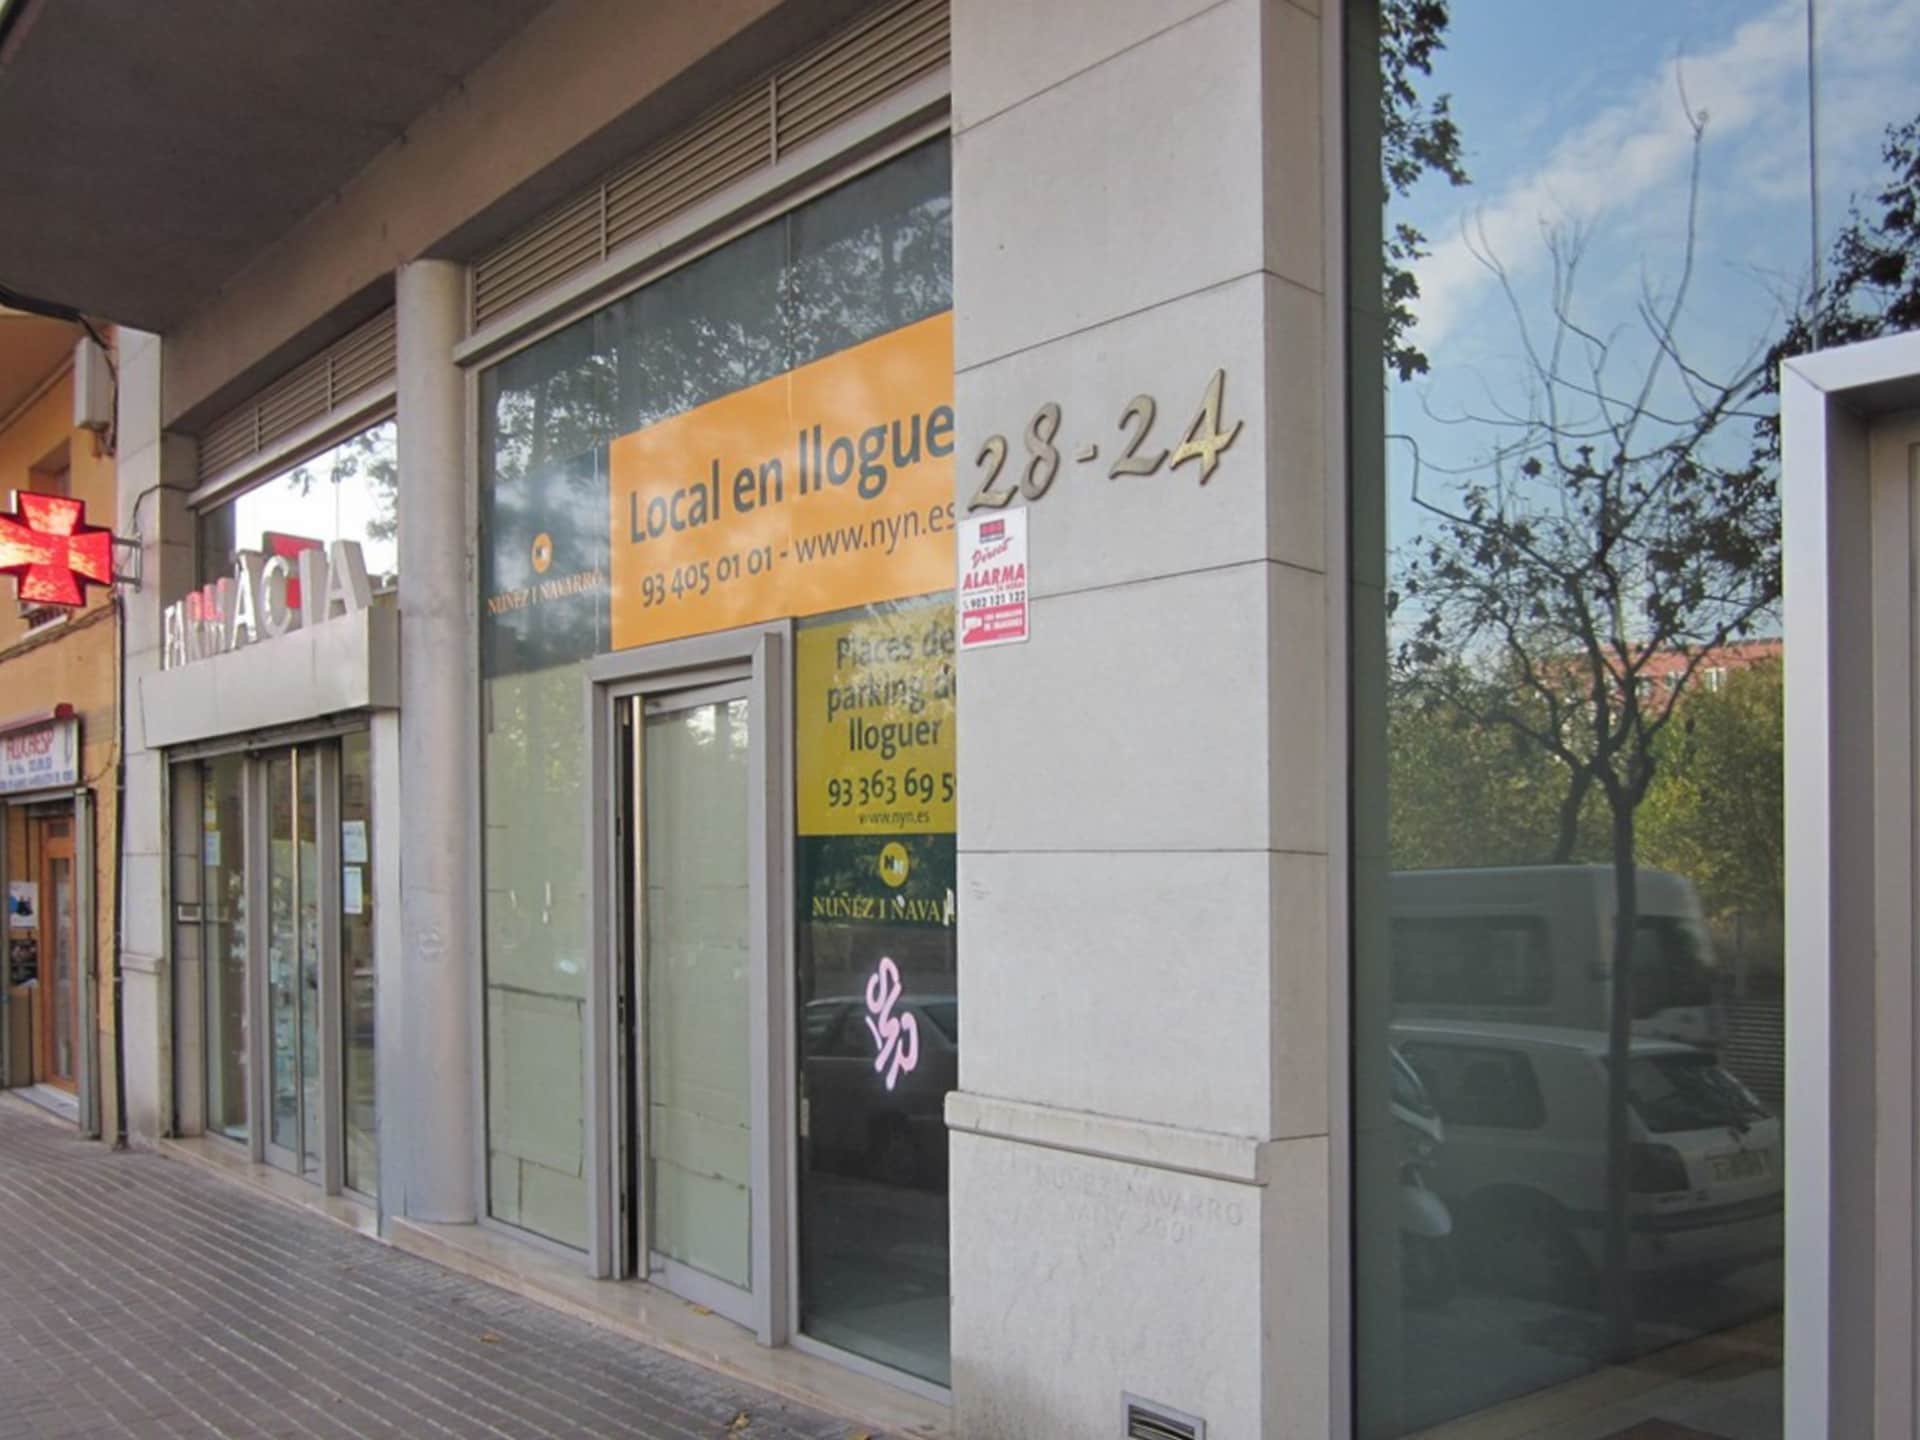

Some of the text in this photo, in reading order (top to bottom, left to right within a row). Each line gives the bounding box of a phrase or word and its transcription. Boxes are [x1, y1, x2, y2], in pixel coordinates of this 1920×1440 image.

[630, 458, 720, 544] Local
[732, 457, 783, 513] en
[642, 573, 666, 608] 93
[671, 560, 710, 599] 405
[716, 554, 740, 582] 01
[747, 545, 773, 576] 01
[795, 500, 955, 563] www.nyn.es
[962, 562, 1025, 591] ALARMA
[163, 538, 372, 671] FARMACIA
[837, 632, 913, 669] Places
[922, 619, 955, 657] de
[827, 670, 926, 723] parking
[849, 716, 943, 761] lloguer
[828, 777, 853, 808] 93
[858, 768, 897, 806] 363
[903, 767, 934, 804] 69
